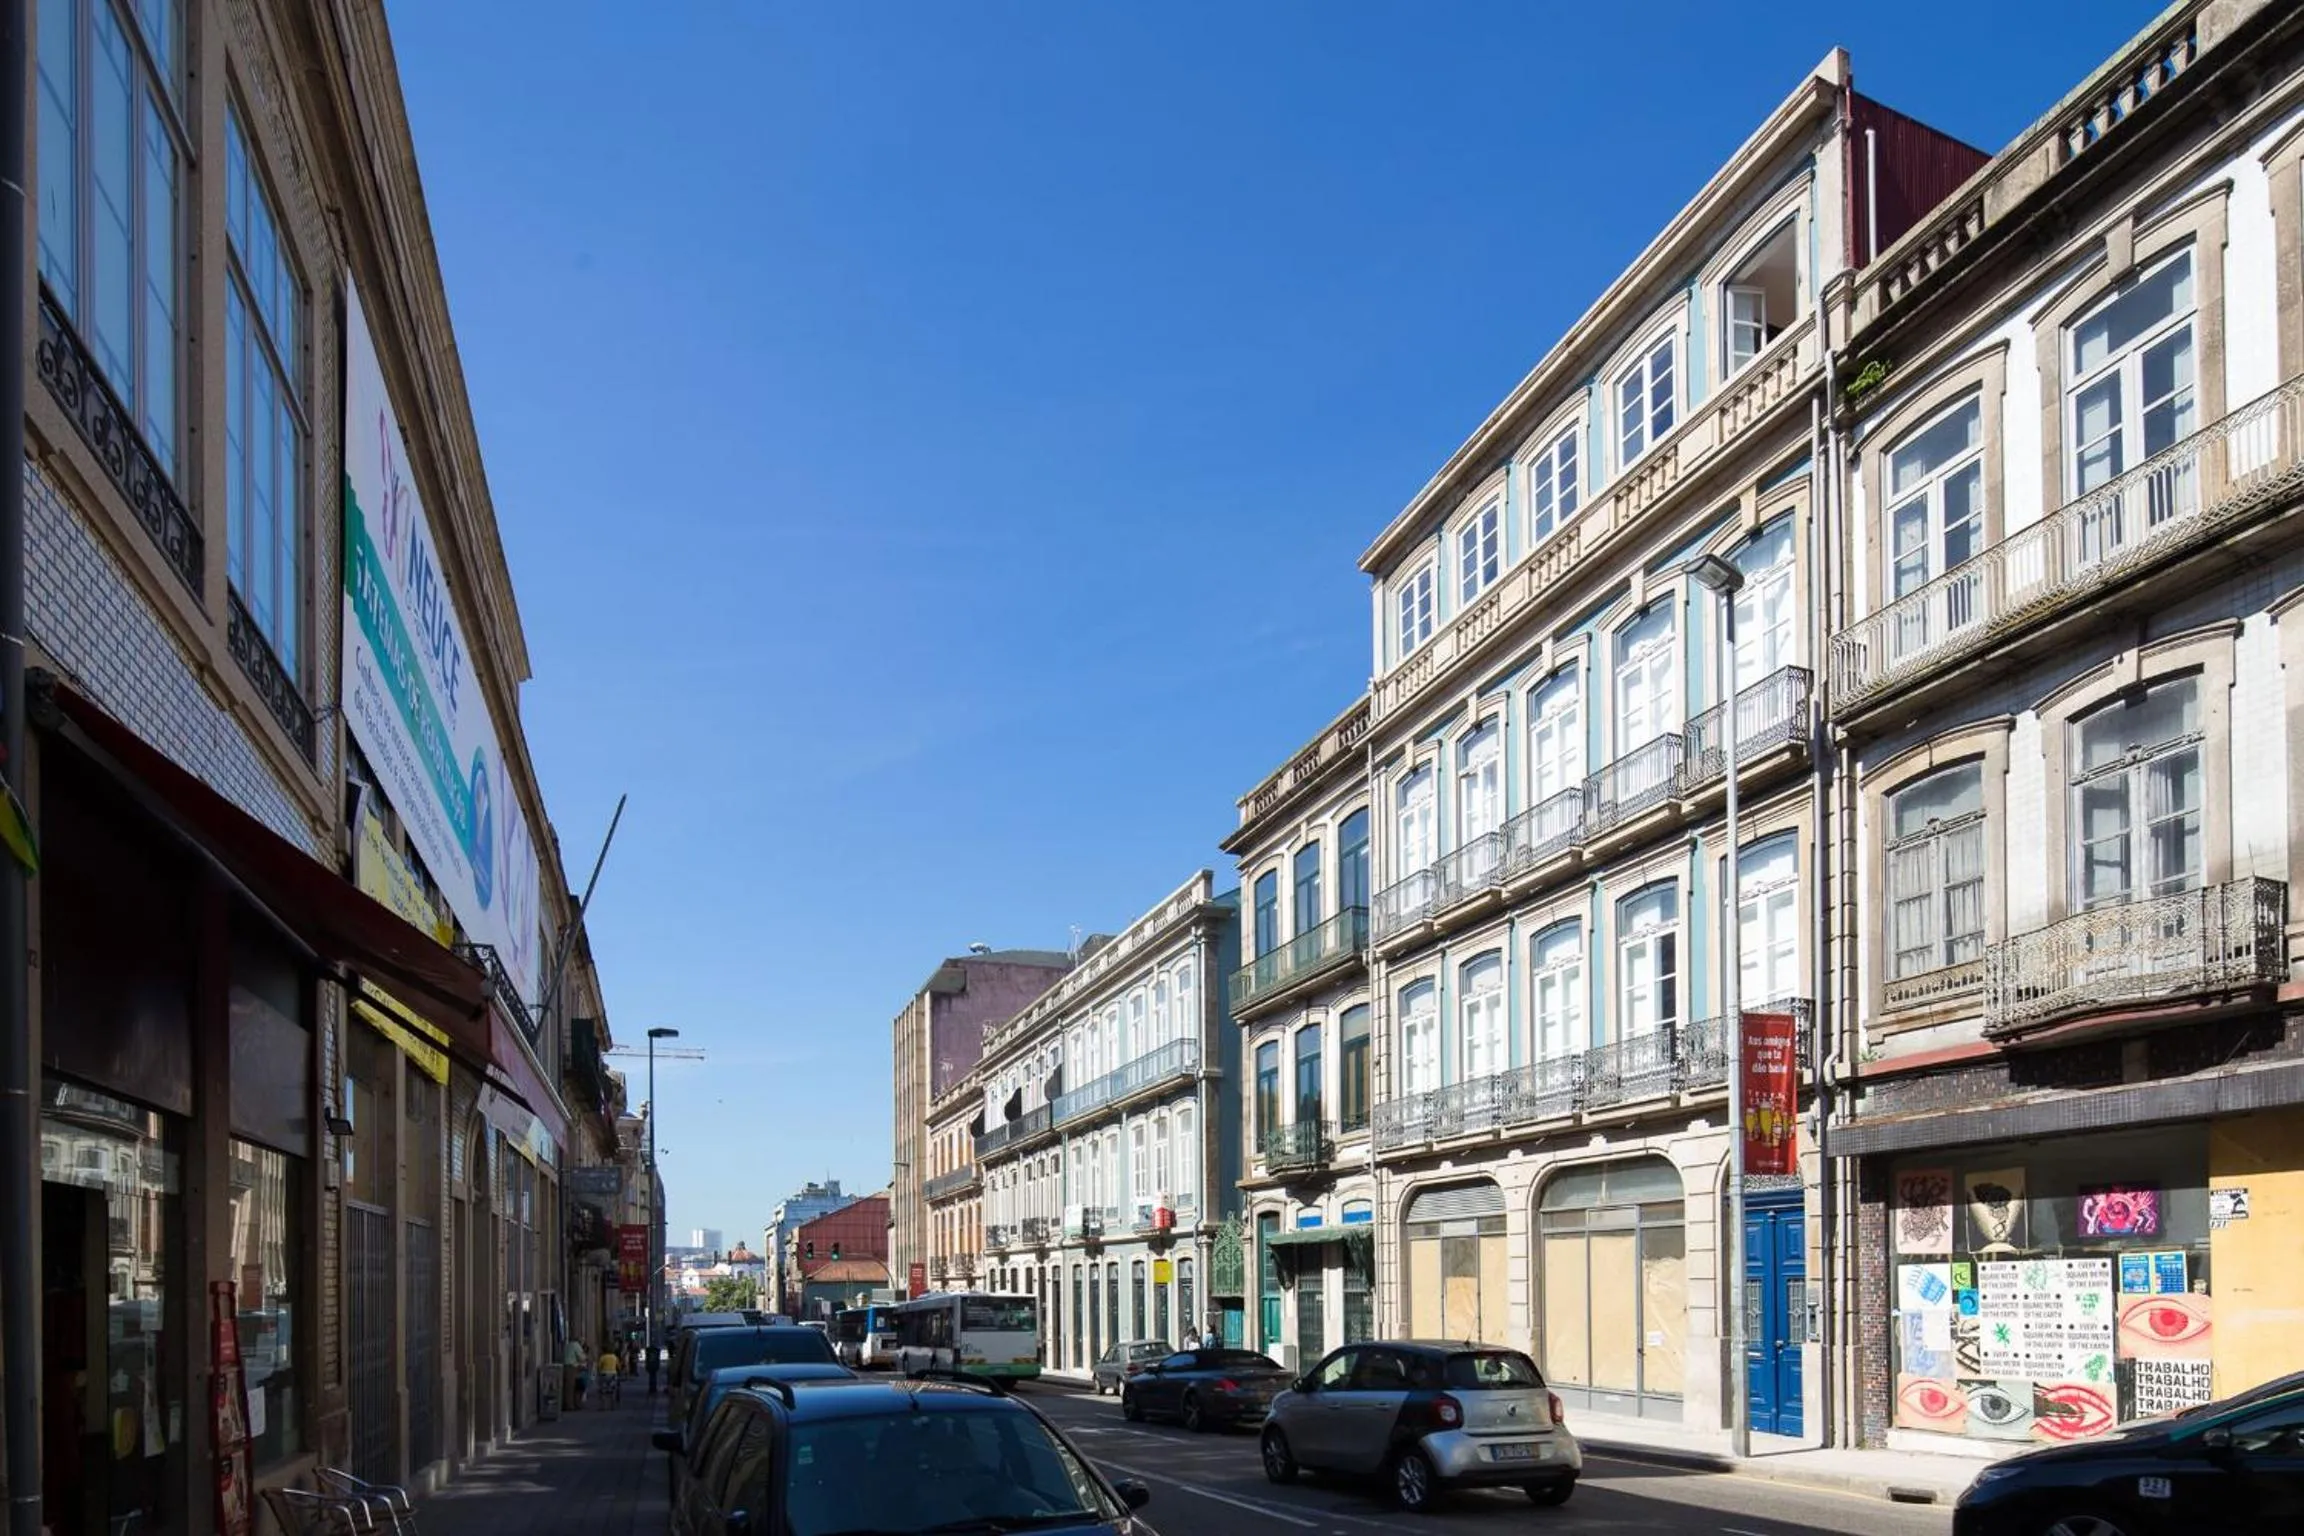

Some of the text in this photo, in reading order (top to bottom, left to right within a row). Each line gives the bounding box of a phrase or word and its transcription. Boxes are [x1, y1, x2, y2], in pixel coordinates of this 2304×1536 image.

[357, 543, 406, 692] SISTEMAS
[408, 514, 460, 713] NEUCE
[2137, 1362, 2210, 1376] TRABALHO
[2138, 1374, 2211, 1388] TRABALHO
[2138, 1386, 2211, 1401] TRABALHO
[2138, 1398, 2194, 1411] TRABA
